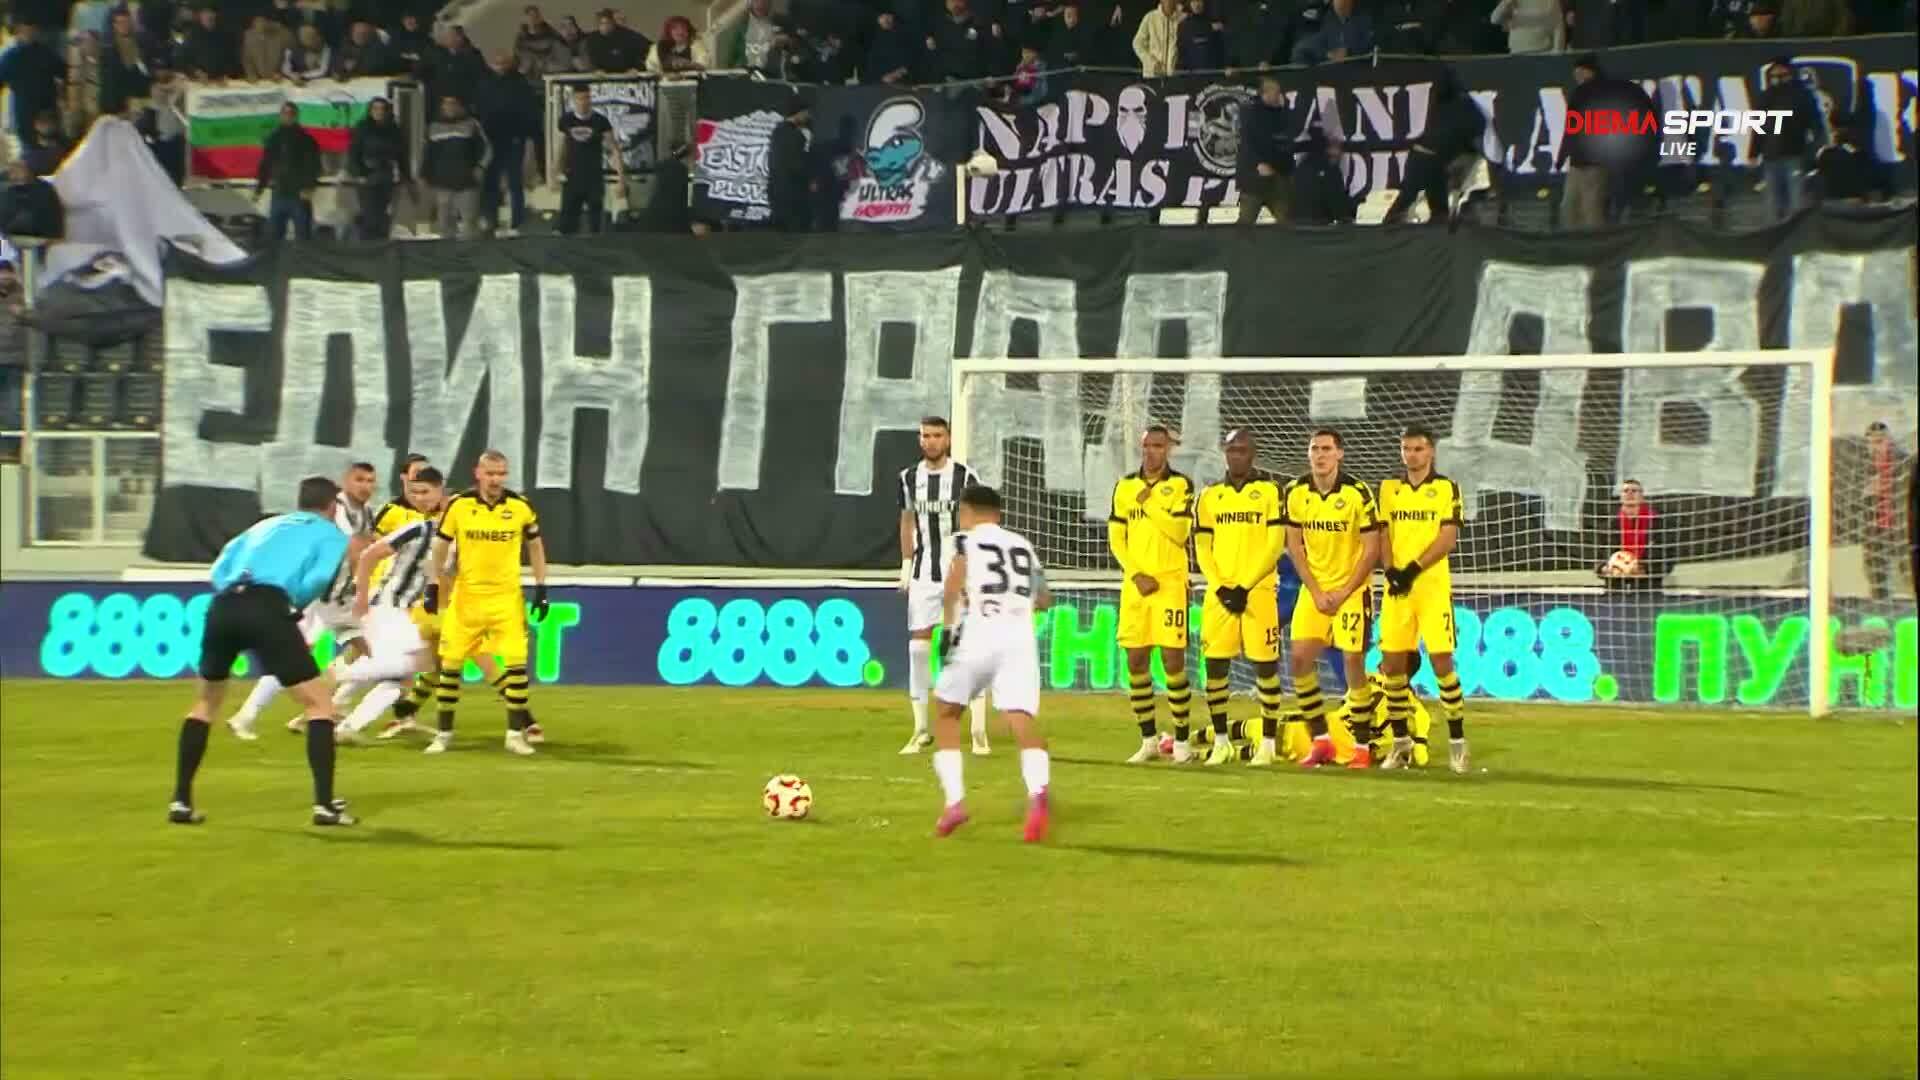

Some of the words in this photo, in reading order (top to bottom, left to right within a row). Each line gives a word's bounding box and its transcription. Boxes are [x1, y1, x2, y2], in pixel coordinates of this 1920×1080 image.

[1468, 73, 1763, 174] LATA
[968, 153, 1171, 215] ULTRAS
[163, 273, 653, 516] ЕДИН
[716, 266, 1228, 521] ГРАД
[1215, 511, 1263, 525] WINBET
[1303, 519, 1349, 532] WINBET
[1390, 509, 1438, 521] WINBET
[464, 529, 516, 542] WINBET
[977, 543, 1032, 598] 39
[40, 592, 249, 679] 888.
[1164, 608, 1184, 627] 30
[1442, 611, 1451, 632] 7
[657, 598, 885, 687] 8888.
